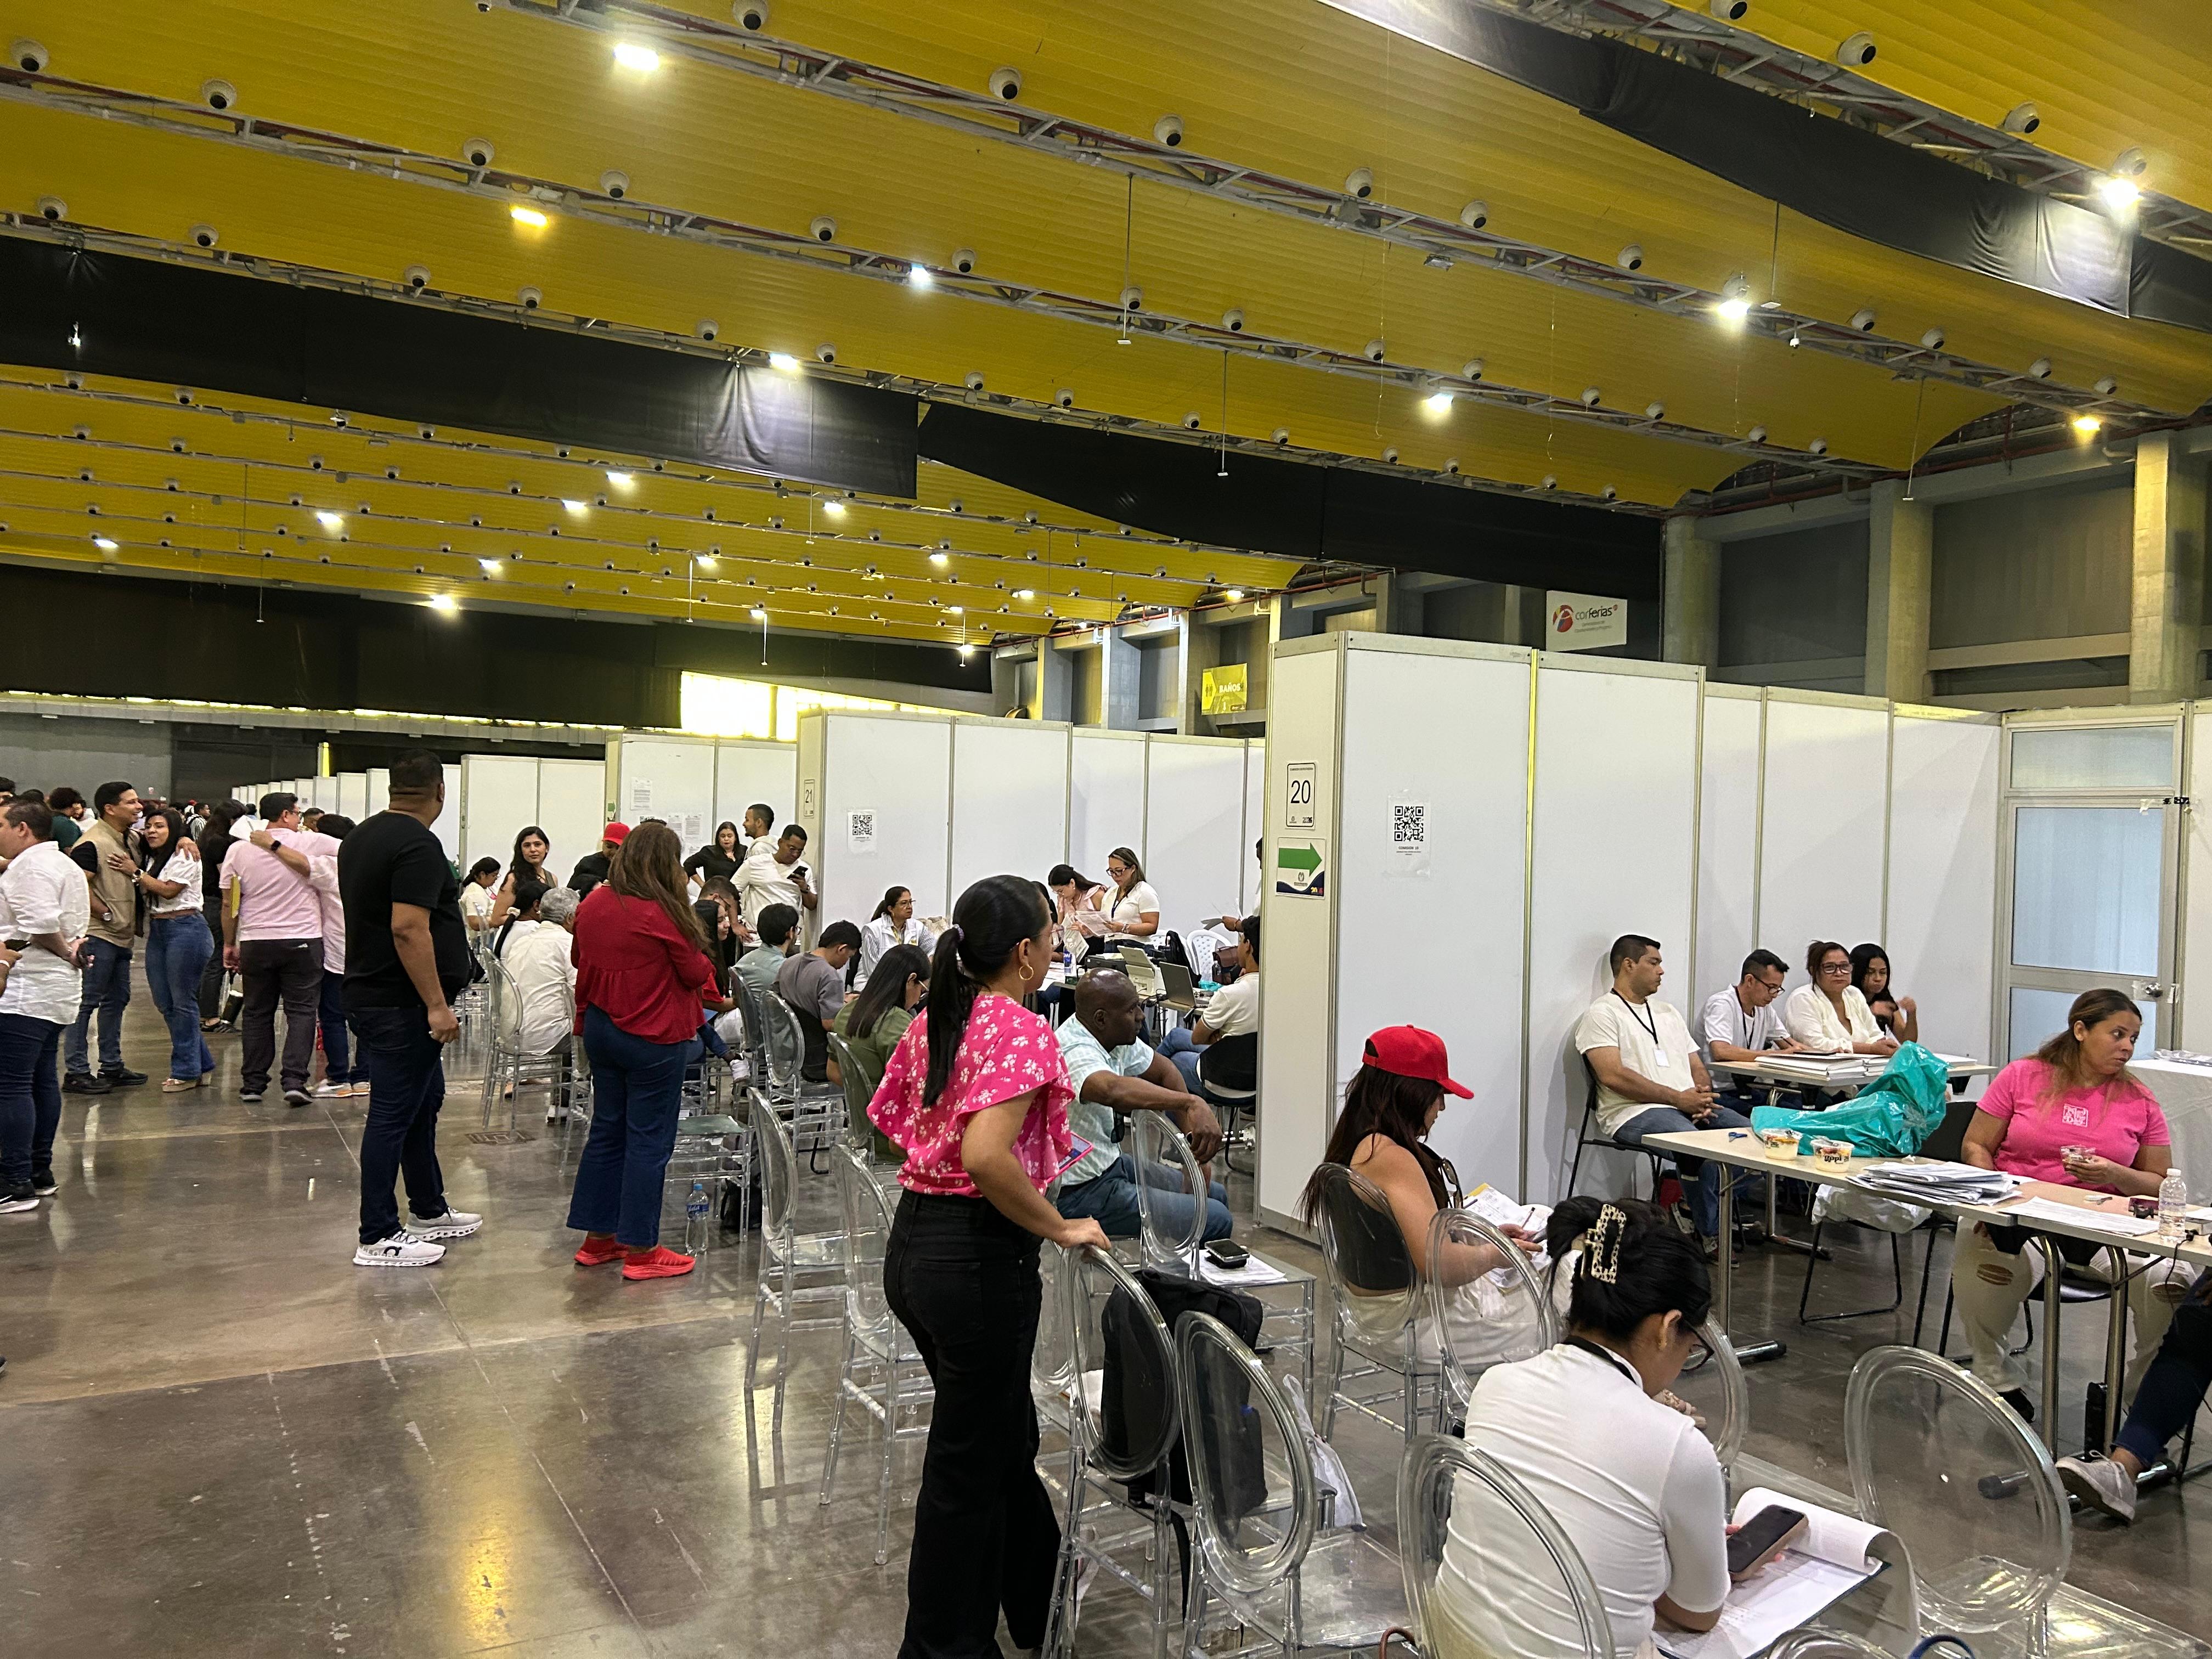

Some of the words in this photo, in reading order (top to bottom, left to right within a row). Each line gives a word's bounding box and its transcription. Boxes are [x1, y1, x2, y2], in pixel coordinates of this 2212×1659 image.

[1575, 605, 1612, 620] corferias
[1219, 682, 1241, 693] BAÑOS
[805, 789, 812, 803] 21
[1290, 780, 1311, 804] 20
